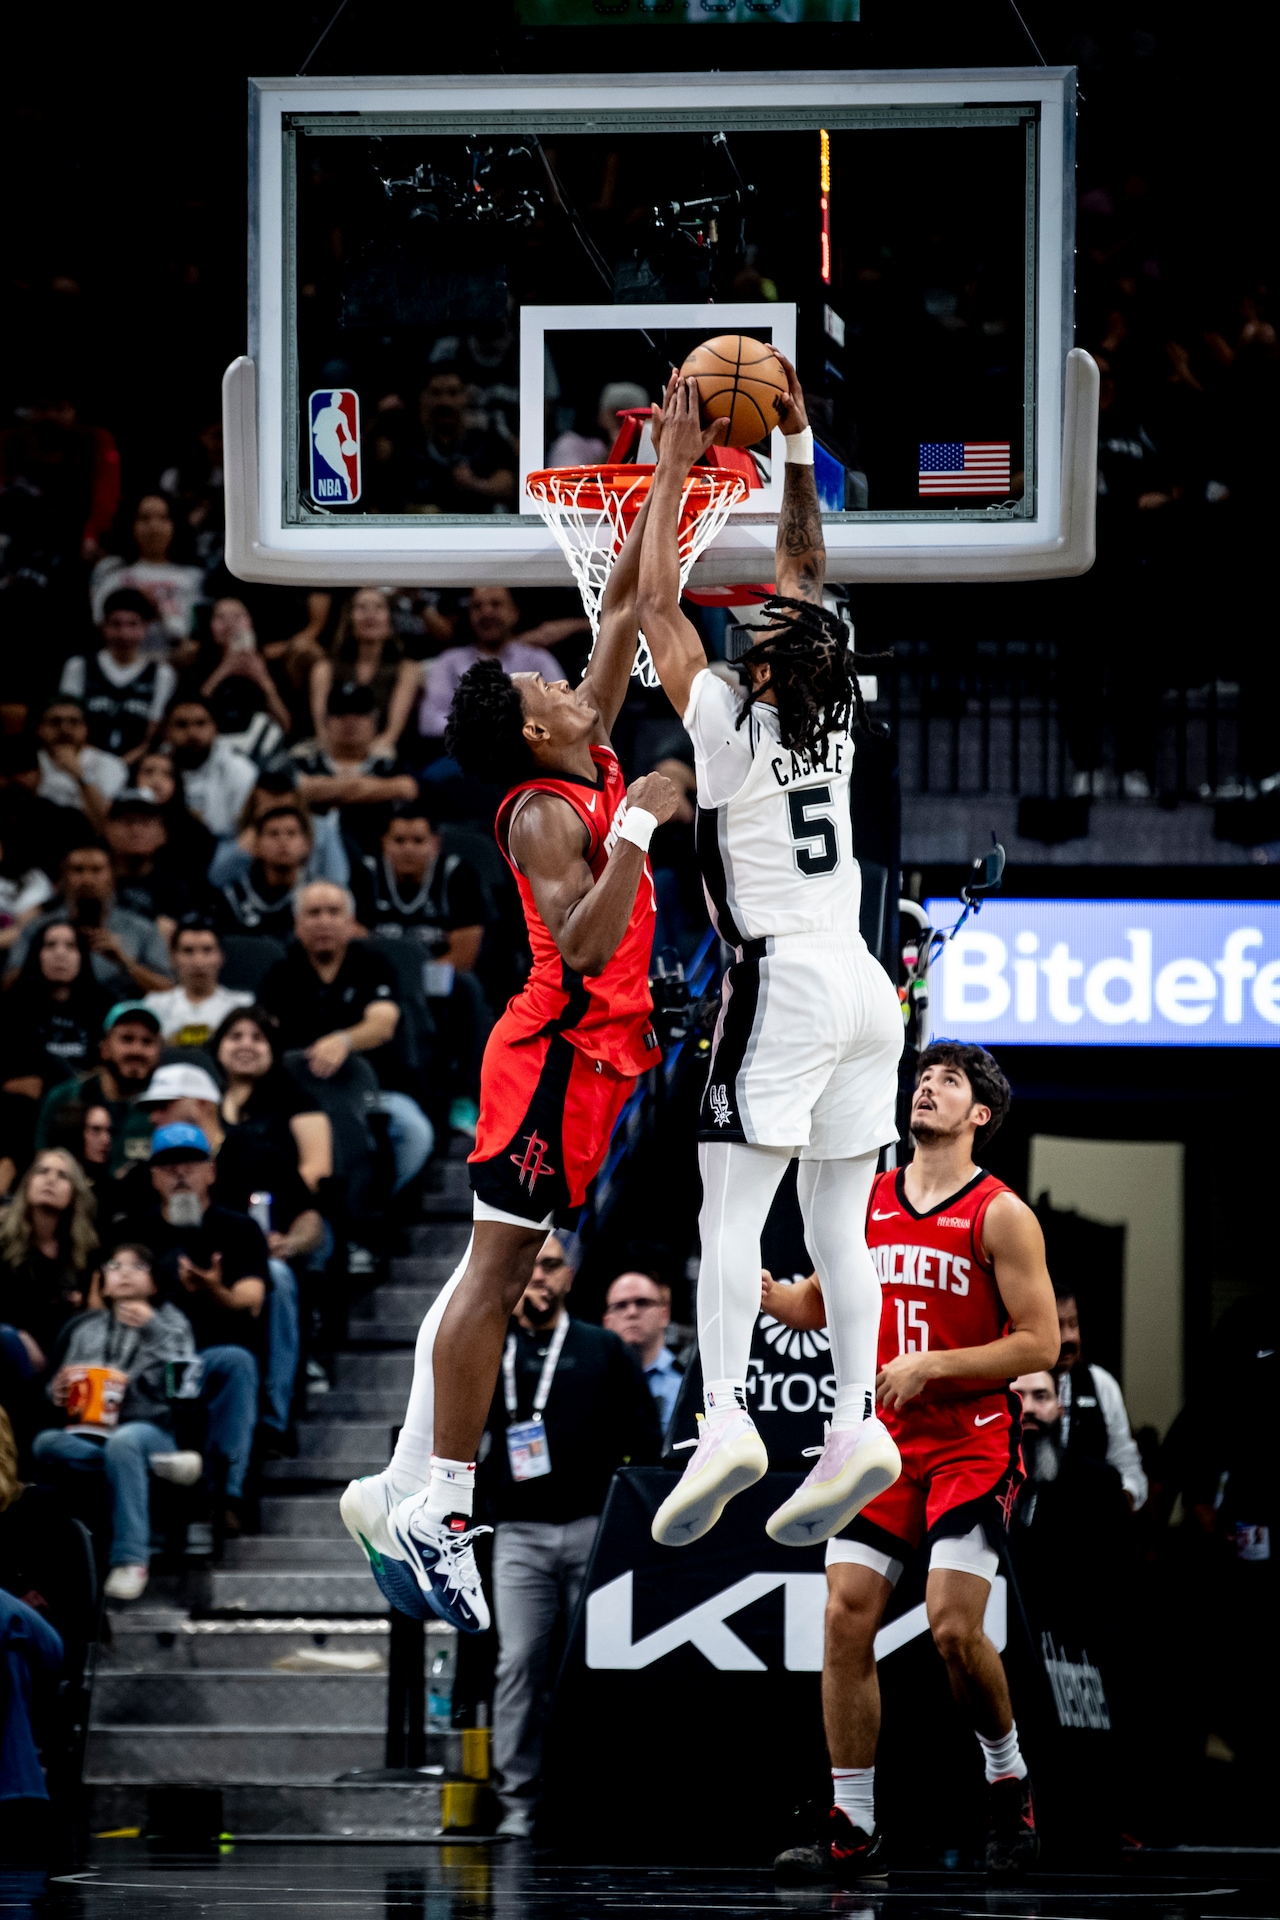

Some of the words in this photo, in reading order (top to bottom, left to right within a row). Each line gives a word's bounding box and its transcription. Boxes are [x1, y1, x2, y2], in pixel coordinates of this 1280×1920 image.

[318, 479, 342, 496] NBA
[771, 744, 843, 786] CASLE
[785, 782, 841, 880] 5
[894, 1298, 929, 1355] 15
